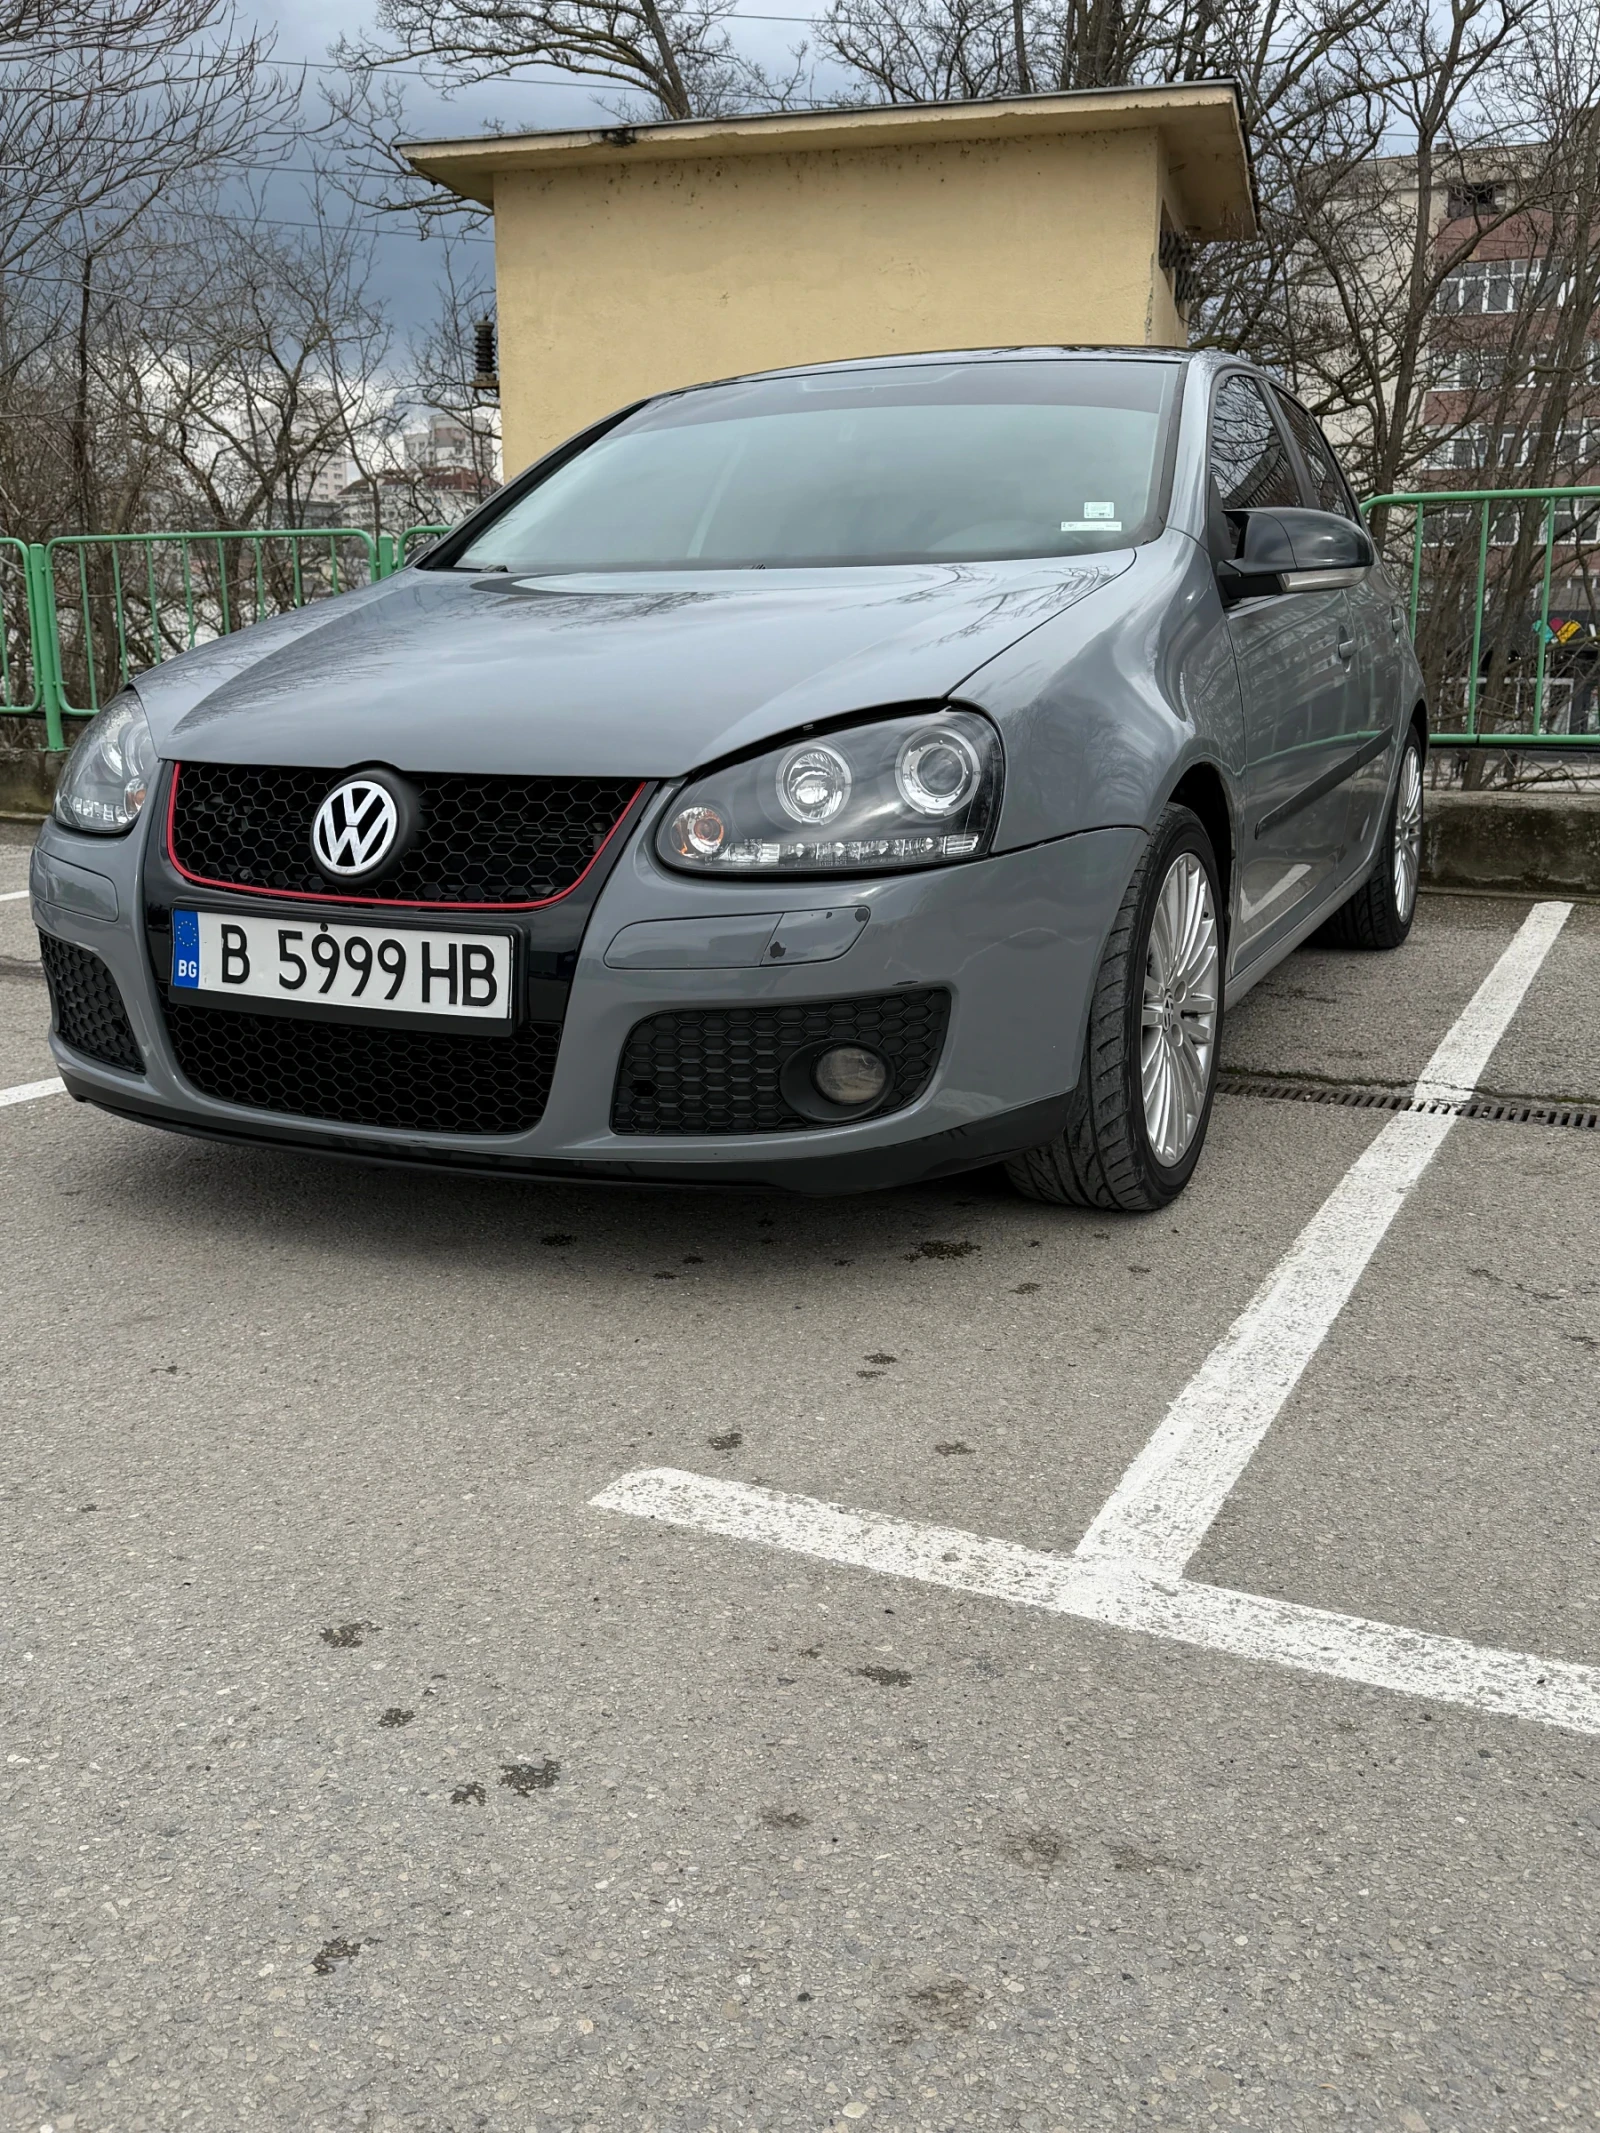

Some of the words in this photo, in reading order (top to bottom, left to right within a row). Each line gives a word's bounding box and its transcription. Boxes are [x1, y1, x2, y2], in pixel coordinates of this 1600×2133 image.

[312, 780, 397, 875] VW
[178, 959, 197, 978] BG
[221, 923, 251, 985] B
[277, 929, 407, 1000] 5999
[421, 941, 498, 1007] HB
